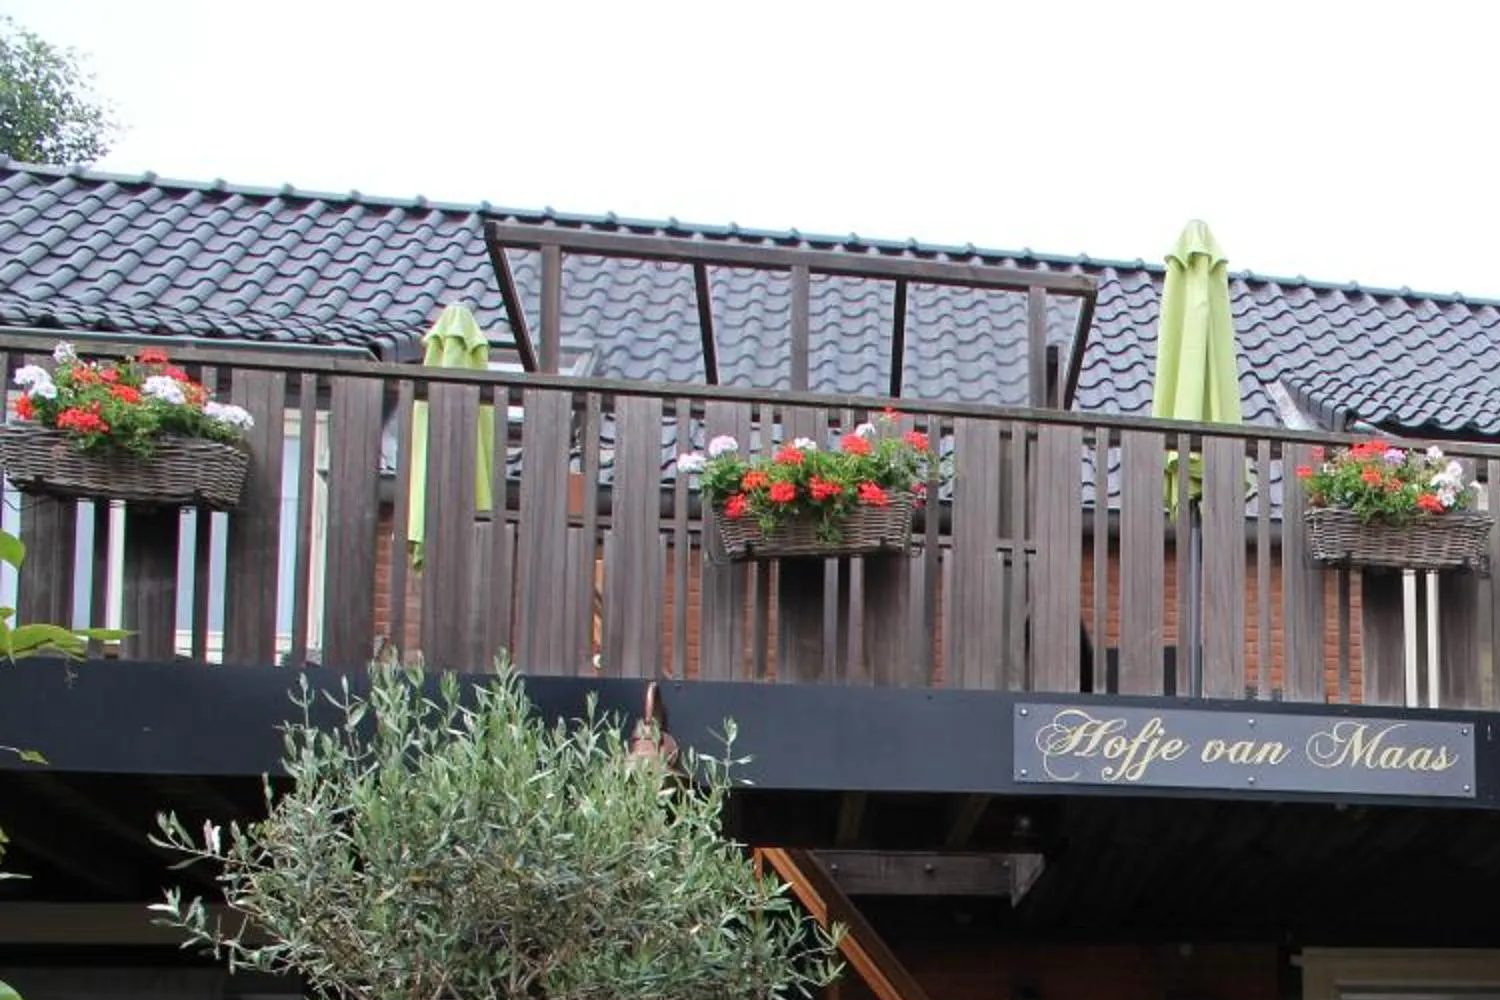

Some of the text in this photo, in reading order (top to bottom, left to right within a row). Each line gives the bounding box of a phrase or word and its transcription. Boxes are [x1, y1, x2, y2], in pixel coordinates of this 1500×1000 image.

[1035, 709, 1458, 781] Hofje van Maas
